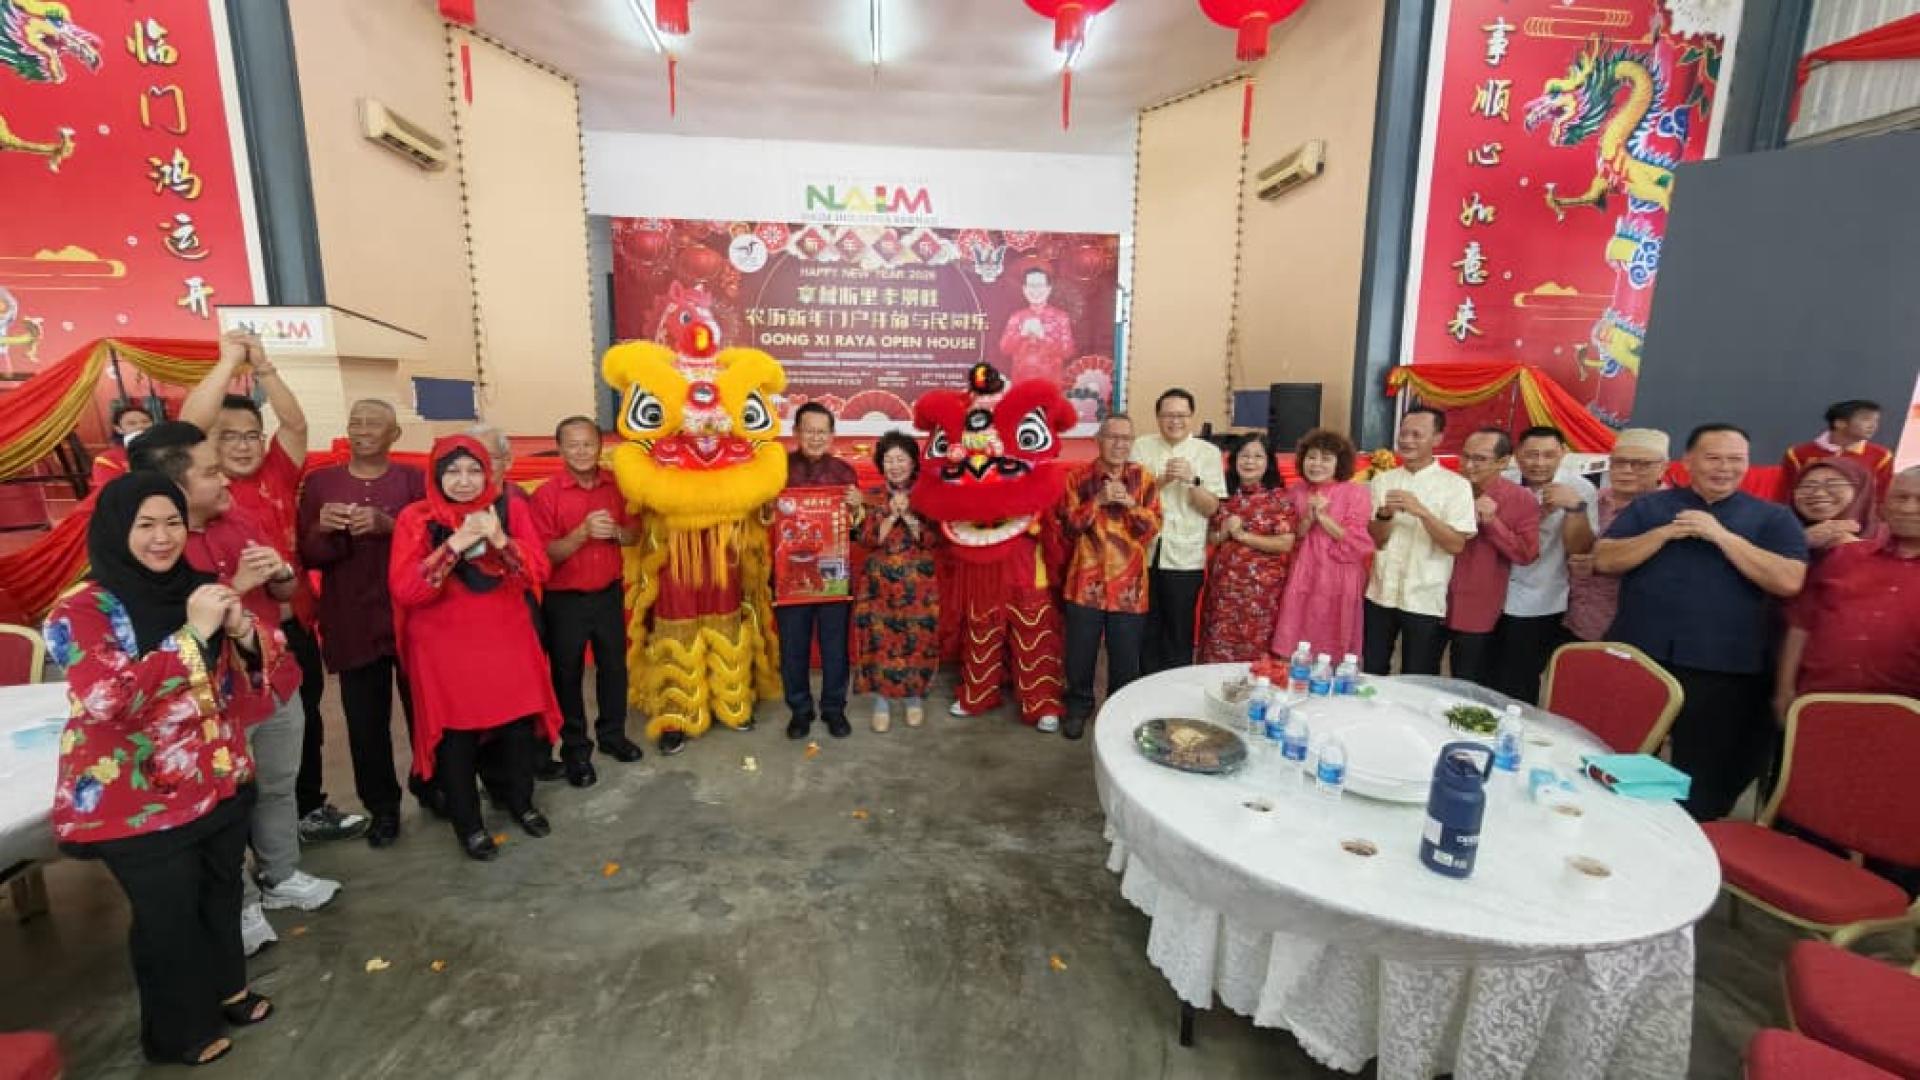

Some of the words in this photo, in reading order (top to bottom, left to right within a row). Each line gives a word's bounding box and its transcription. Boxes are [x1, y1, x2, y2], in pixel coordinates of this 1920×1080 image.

[806, 183, 933, 214] NAIM
[761, 333, 809, 347] GONG
[815, 334, 830, 347] XI
[836, 334, 876, 348] RAYA
[881, 335, 923, 348] OPEN
[927, 336, 977, 350] HOUSE
